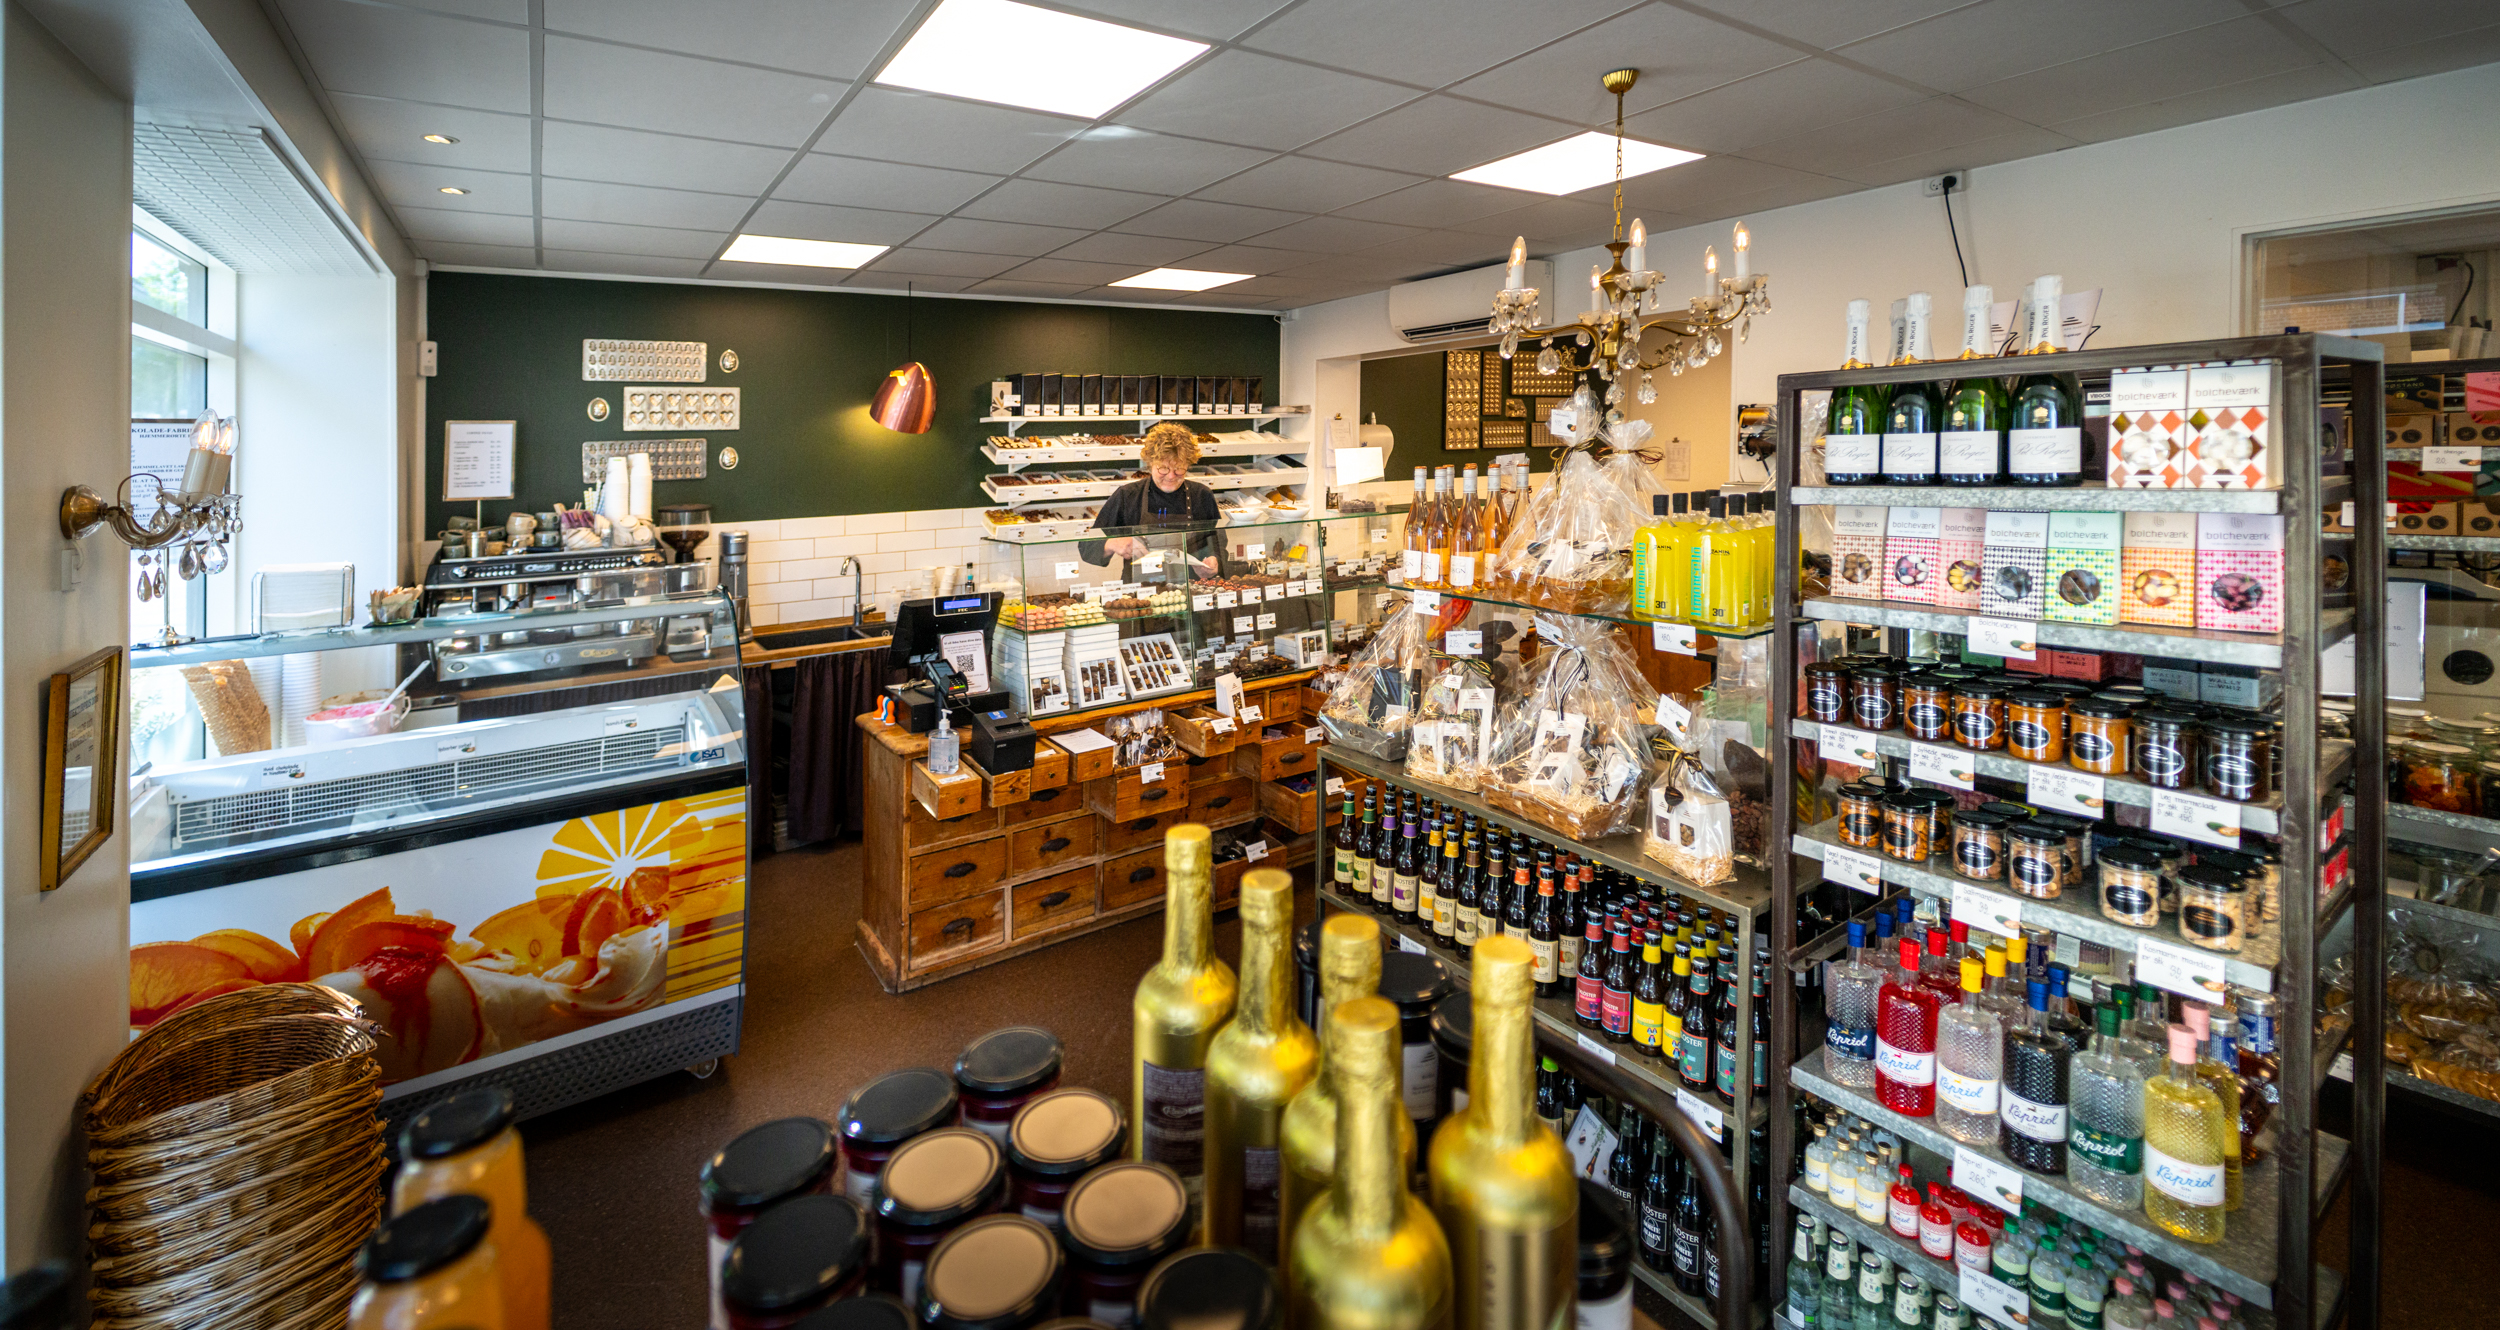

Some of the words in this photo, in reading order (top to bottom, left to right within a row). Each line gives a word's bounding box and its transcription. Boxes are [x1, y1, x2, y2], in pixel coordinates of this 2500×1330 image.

[2042, 305, 2050, 324] ROGER
[1967, 314, 1976, 333] ROGER
[2118, 391, 2178, 402] bolcheværk
[2195, 386, 2261, 397] bolcheværk
[1840, 446, 1874, 461] Roger
[1892, 445, 1929, 461] Roger
[1951, 444, 1991, 460] Roger
[2031, 441, 2075, 459] Roger
[1838, 520, 1878, 528] bolcheværk
[1892, 521, 1936, 530] bolcheværk
[1945, 524, 1986, 532] bolchevær
[1991, 529, 2041, 538] bolcheværk
[2054, 530, 2109, 540] bolcheværk
[2130, 530, 2189, 539] bolcheværk
[2206, 532, 2271, 541] bolcheværk
[2208, 677, 2242, 685] WALLY
[2181, 956, 2217, 972] mandler
[1827, 1026, 1868, 1047] Kapriol
[1879, 1050, 1923, 1071] Kapriol
[1939, 1075, 1984, 1098] Kapriol
[2008, 1102, 2059, 1125] Kapriol
[2071, 1128, 2127, 1157] Kapriol
[2156, 1164, 2216, 1188] Kapriol
